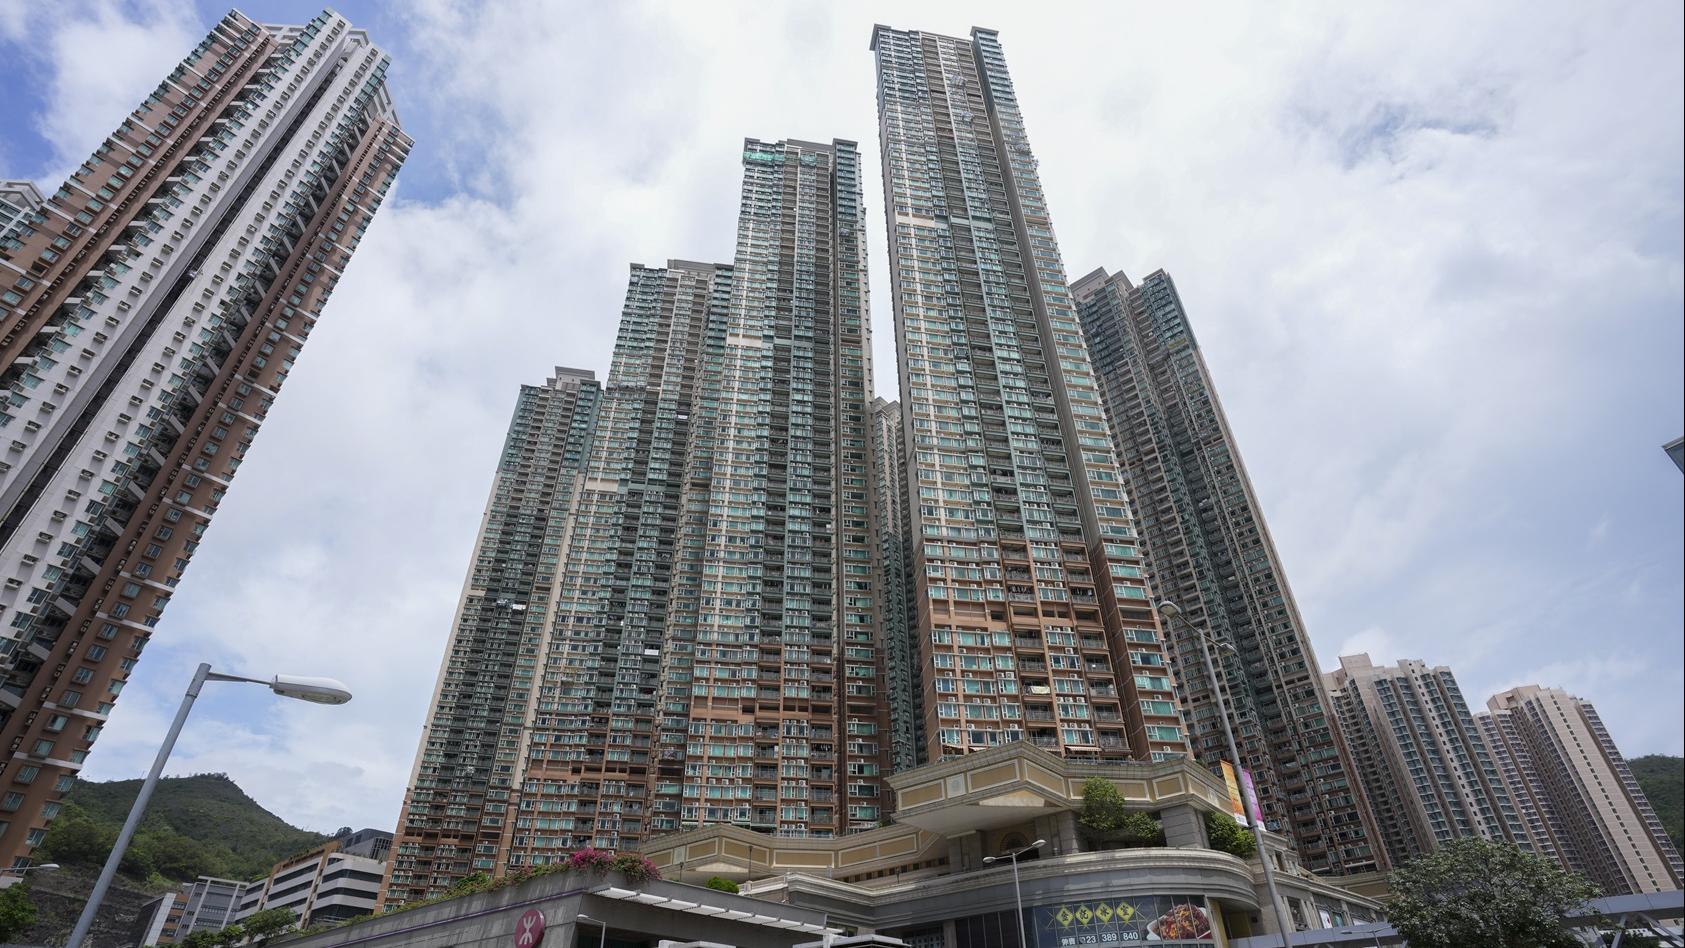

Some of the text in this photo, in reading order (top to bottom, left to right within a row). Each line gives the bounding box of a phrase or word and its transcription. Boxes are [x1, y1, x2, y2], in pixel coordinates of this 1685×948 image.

[1086, 935, 1096, 944] 23
[1101, 933, 1117, 941] 389
[1123, 932, 1139, 940] 840
